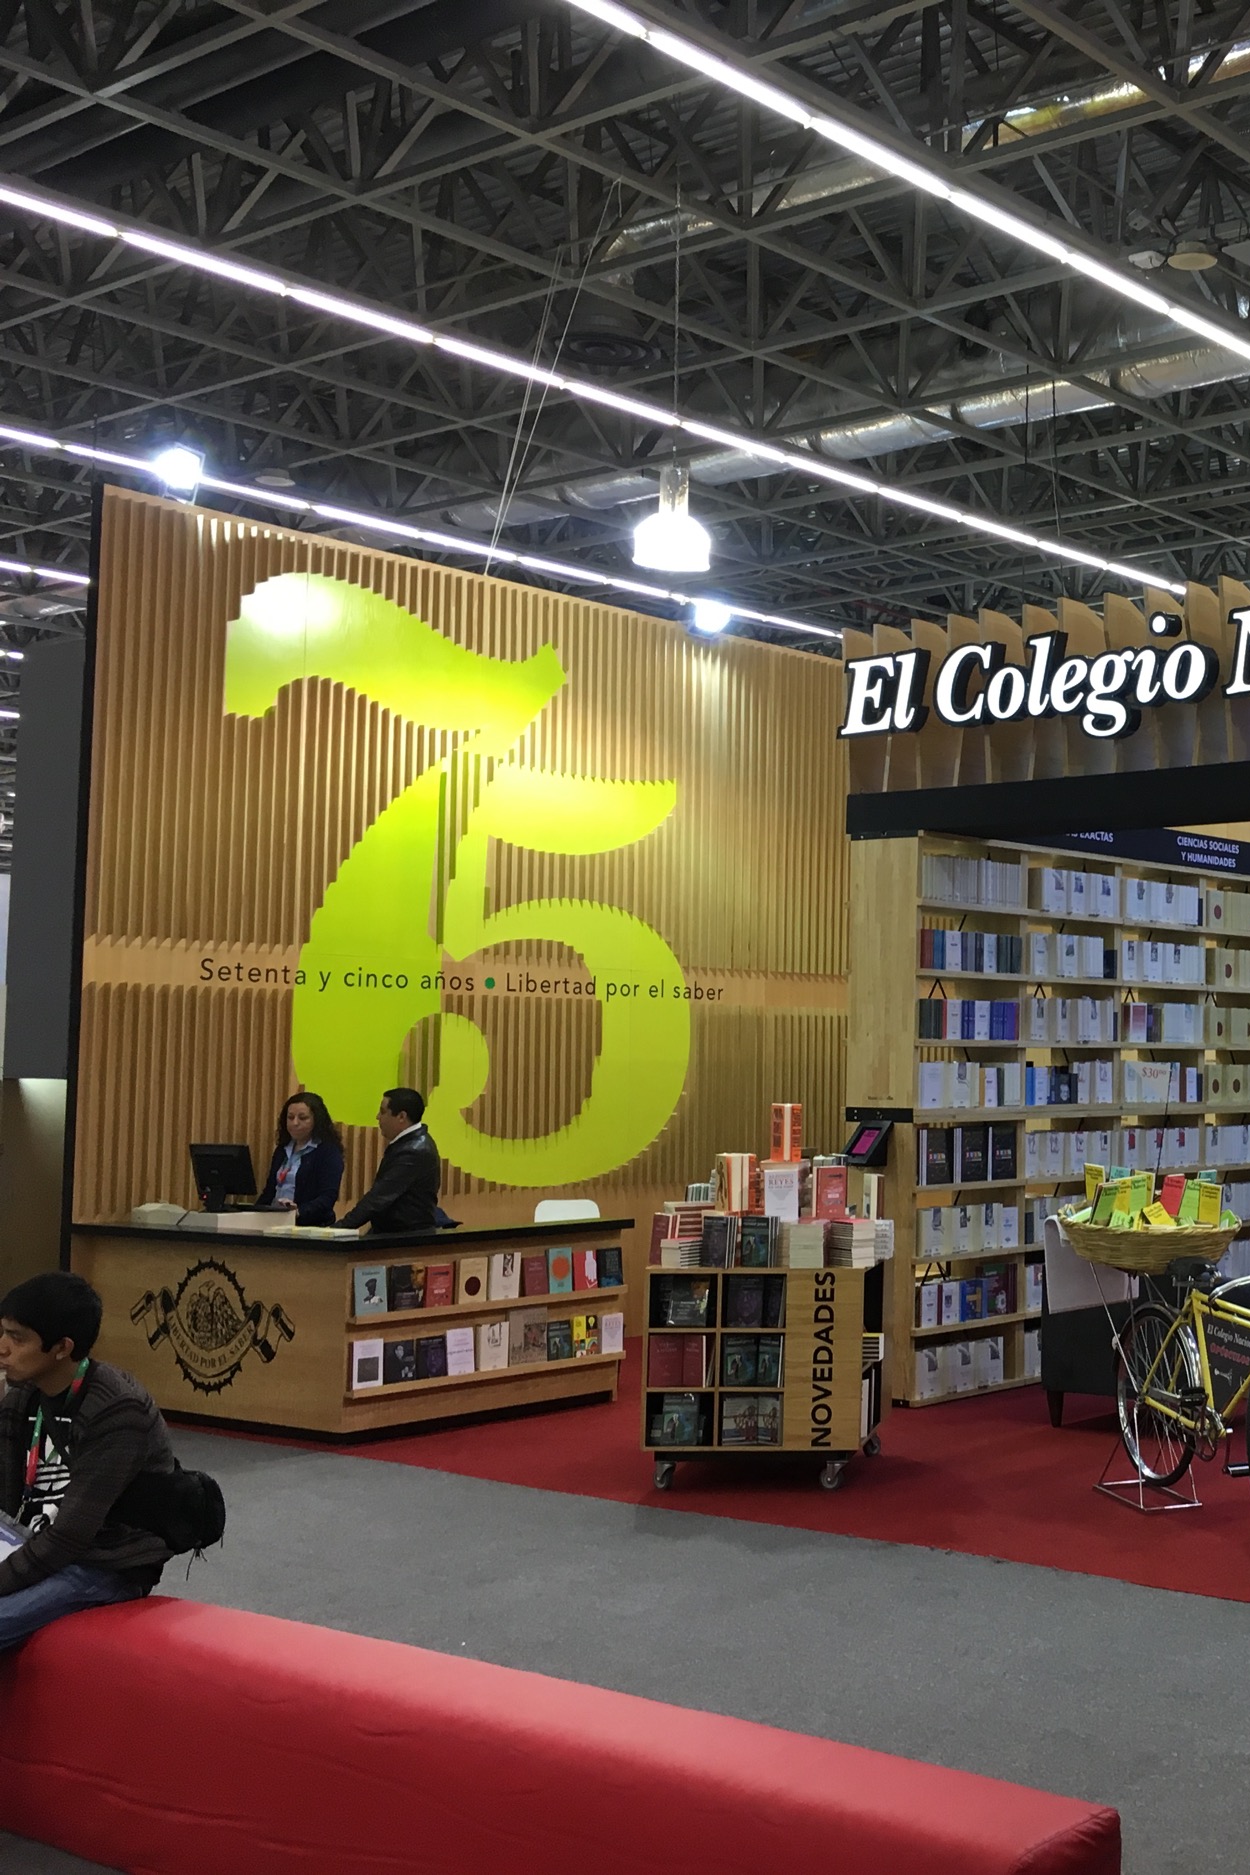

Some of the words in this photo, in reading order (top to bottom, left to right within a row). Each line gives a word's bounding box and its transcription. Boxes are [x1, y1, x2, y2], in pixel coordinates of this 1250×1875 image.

[840, 650, 920, 736] El
[938, 615, 1203, 737] Colegio
[1177, 835, 1208, 850] CIENCIAS
[1208, 840, 1240, 855] SOCIALES
[1181, 851, 1186, 861] Y
[1187, 852, 1236, 868] HUMANIDADES
[199, 958, 307, 986] Setenta
[319, 971, 332, 991] y
[344, 966, 409, 990] cinco
[420, 970, 475, 992] años
[505, 972, 596, 996] Libertad
[606, 981, 642, 1002] por
[648, 978, 665, 999] el
[673, 980, 724, 1001] saber
[1207, 1323, 1214, 1335] El
[1214, 1326, 1234, 1343] Colegio
[200, 1357, 217, 1368] POR
[811, 1272, 836, 1447] NOVEDADES
